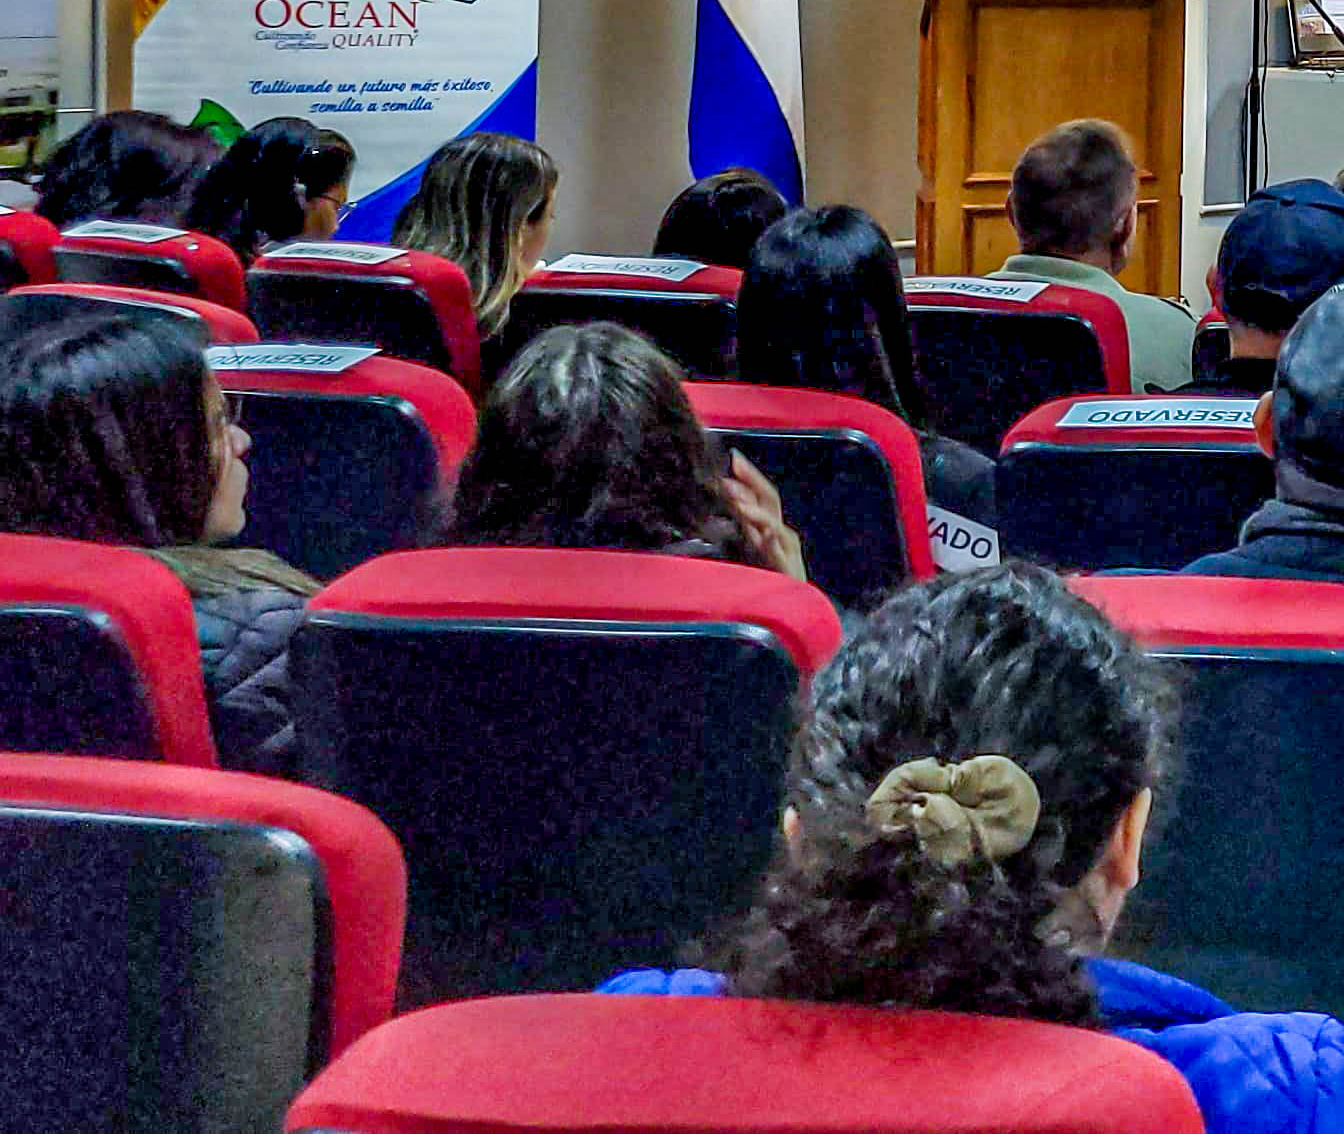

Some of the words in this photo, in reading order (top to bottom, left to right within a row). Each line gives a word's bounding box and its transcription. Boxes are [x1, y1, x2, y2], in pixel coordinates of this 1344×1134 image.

[332, 32, 419, 50] QUALITY
[336, 82, 356, 93] un
[359, 79, 407, 97] futuro
[410, 77, 439, 92] más
[309, 97, 363, 113] semilla
[366, 101, 378, 112] a
